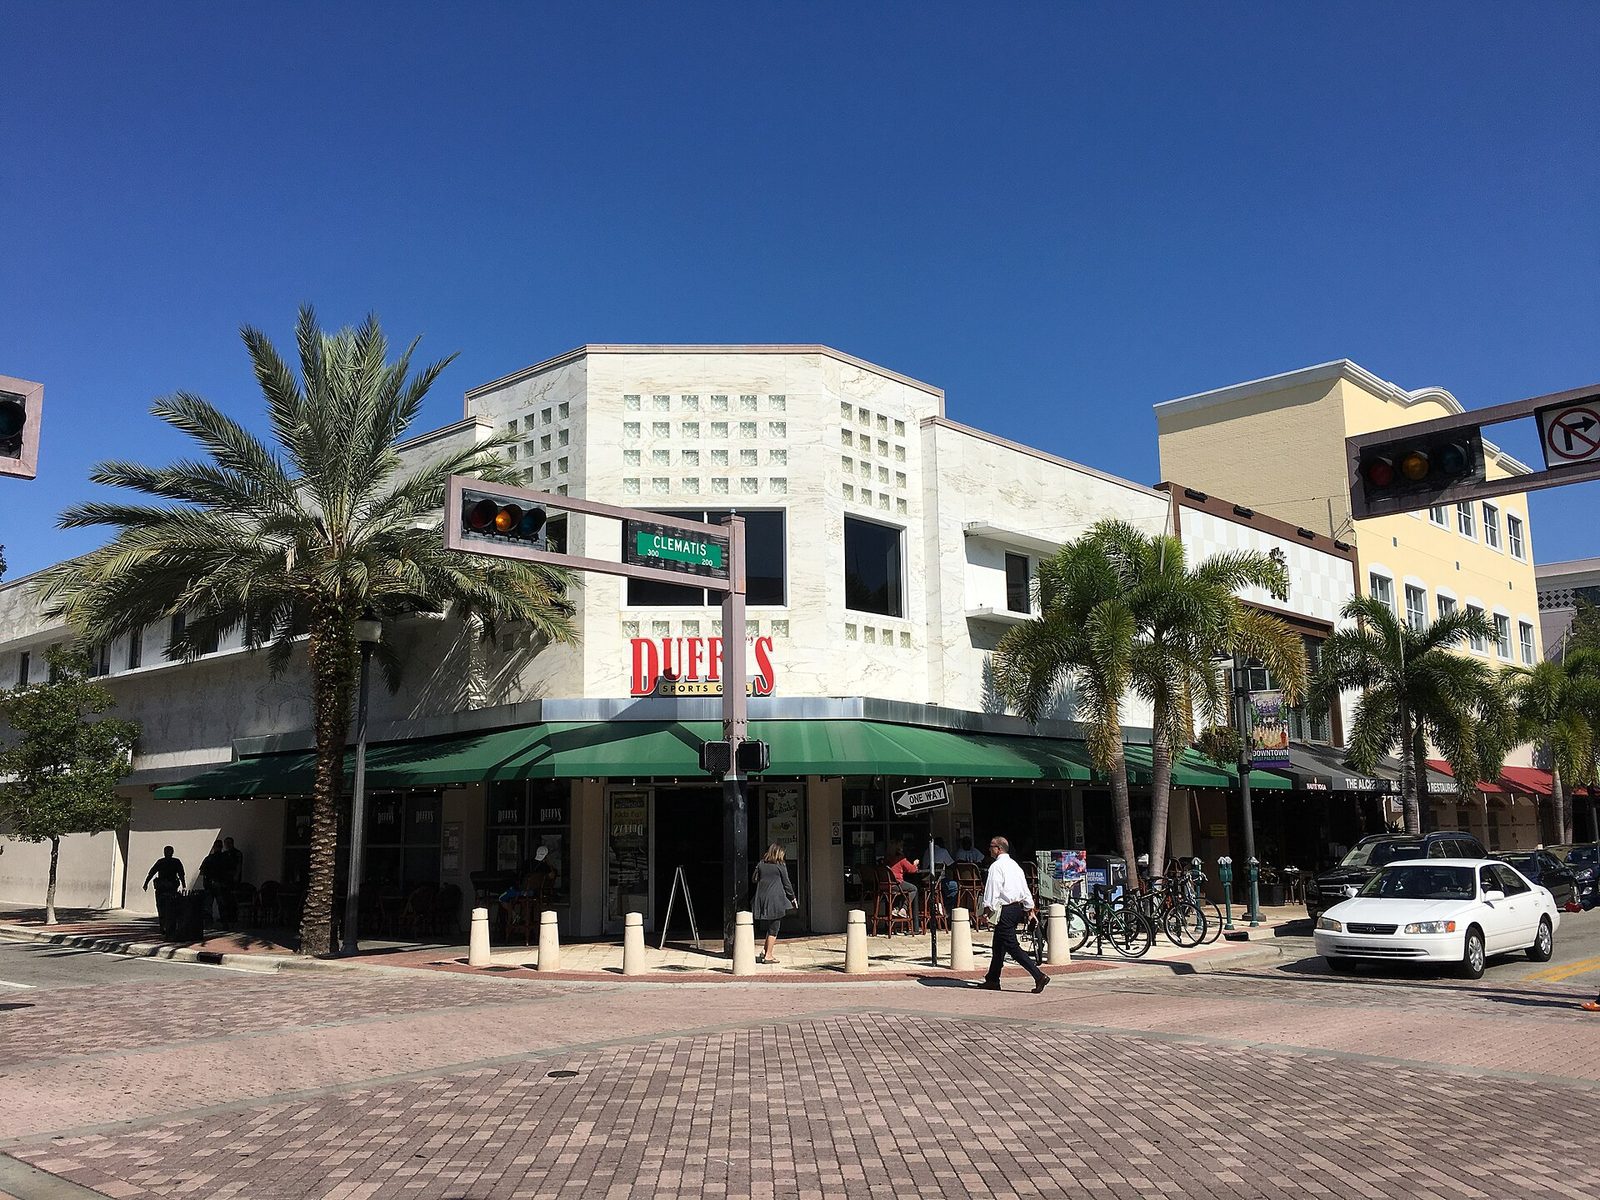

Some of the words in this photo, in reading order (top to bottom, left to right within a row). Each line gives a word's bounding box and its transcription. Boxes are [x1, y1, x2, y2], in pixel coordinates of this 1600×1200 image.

[653, 535, 707, 557] CLEMATIS
[647, 549, 660, 557] 300
[701, 558, 713, 567] 200
[630, 636, 775, 694] DUFF'S
[662, 684, 709, 693] SPORTS
[1345, 778, 1358, 789] THE
[909, 794, 924, 804] ONE
[925, 788, 943, 801] WAY
